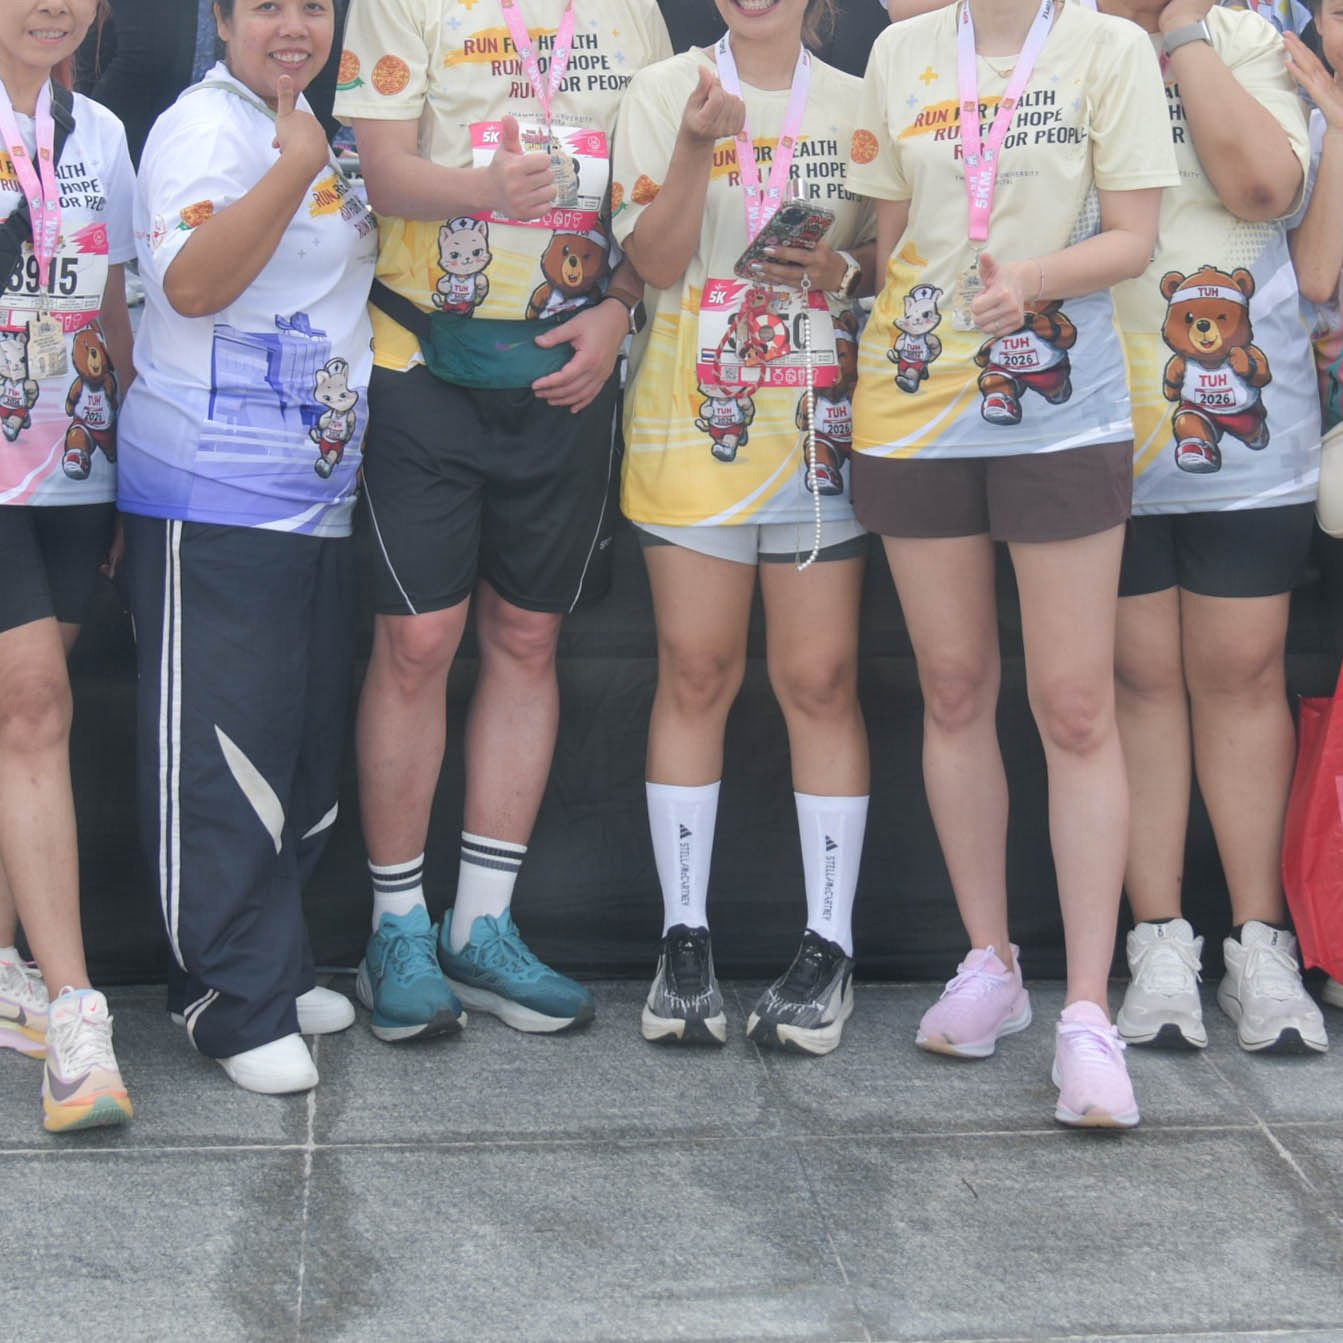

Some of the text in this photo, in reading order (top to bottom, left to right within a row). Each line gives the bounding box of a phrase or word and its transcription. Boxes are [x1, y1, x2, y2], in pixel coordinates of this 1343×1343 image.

[463, 38, 498, 56] RUN
[568, 55, 610, 72] HOPE
[913, 108, 948, 128] RUN
[1016, 107, 1063, 128] HOPE
[482, 130, 501, 143] 5K
[805, 162, 846, 178] HOPE
[61, 178, 100, 194] HOPE
[708, 291, 726, 305] 5K
[1197, 287, 1220, 298] TUH
[1001, 337, 1030, 351] TUH
[1003, 353, 1033, 366] 2026
[1199, 374, 1228, 388] TUH
[1199, 393, 1231, 406] 2026
[825, 406, 847, 419] TUH
[827, 423, 851, 434] 2026
